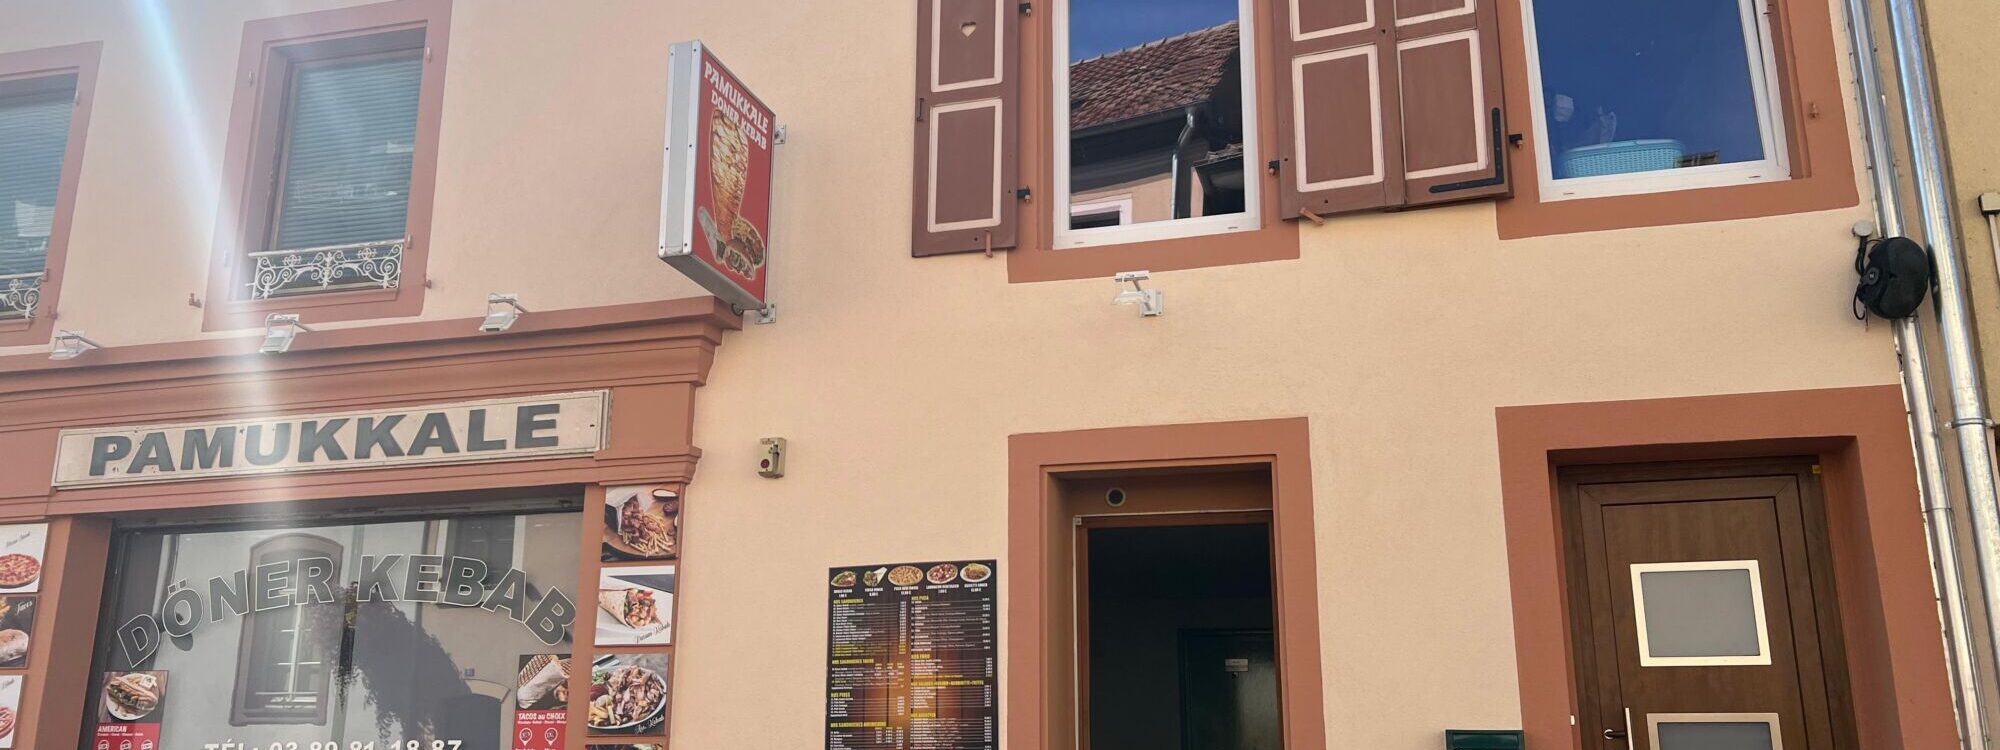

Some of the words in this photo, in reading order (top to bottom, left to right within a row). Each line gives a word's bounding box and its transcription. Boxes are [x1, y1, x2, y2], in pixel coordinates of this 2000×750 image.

[704, 61, 769, 134] PAMUKKALE
[740, 118, 767, 150] KEBAB
[89, 403, 560, 476] PAMUKKALE
[117, 556, 335, 668] DÖNER
[356, 553, 577, 646] KEBAB
[518, 712, 537, 720] TACOS
[546, 712, 566, 720] CHOIX
[204, 738, 258, 750] TÉ
